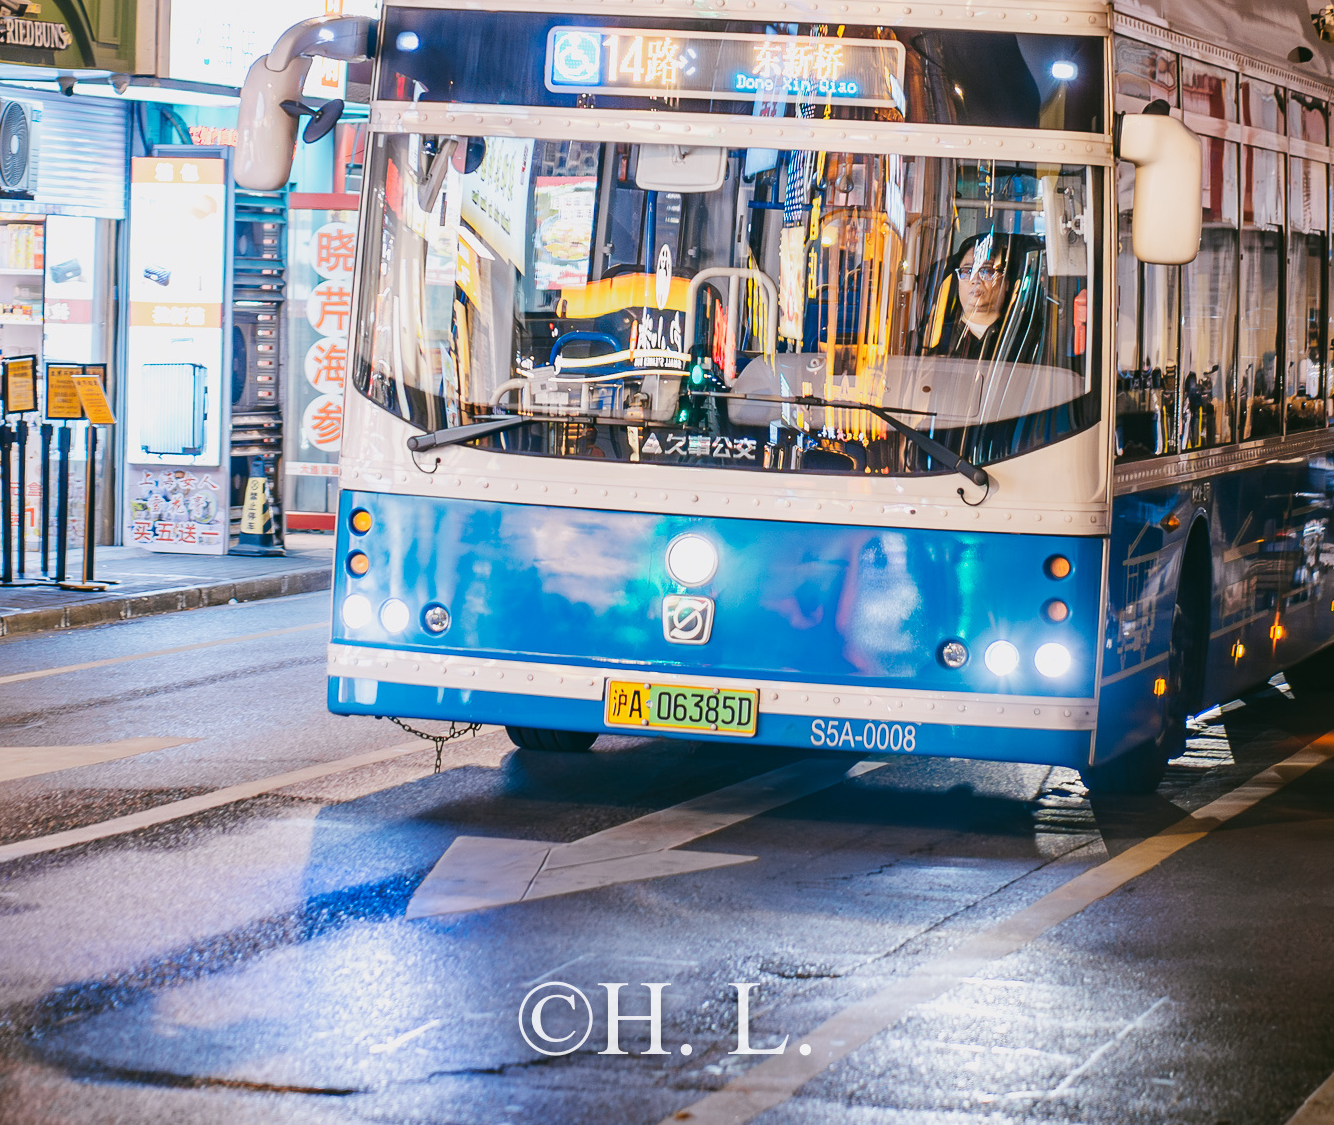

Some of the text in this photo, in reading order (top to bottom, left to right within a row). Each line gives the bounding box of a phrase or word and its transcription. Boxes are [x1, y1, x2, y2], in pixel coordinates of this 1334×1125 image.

[752, 41, 845, 80] 东新桥
[736, 73, 774, 92] Dong
[312, 228, 355, 446] 晓芹海参
[134, 521, 220, 544] 买五送一
[810, 719, 917, 753] S5A-0008
